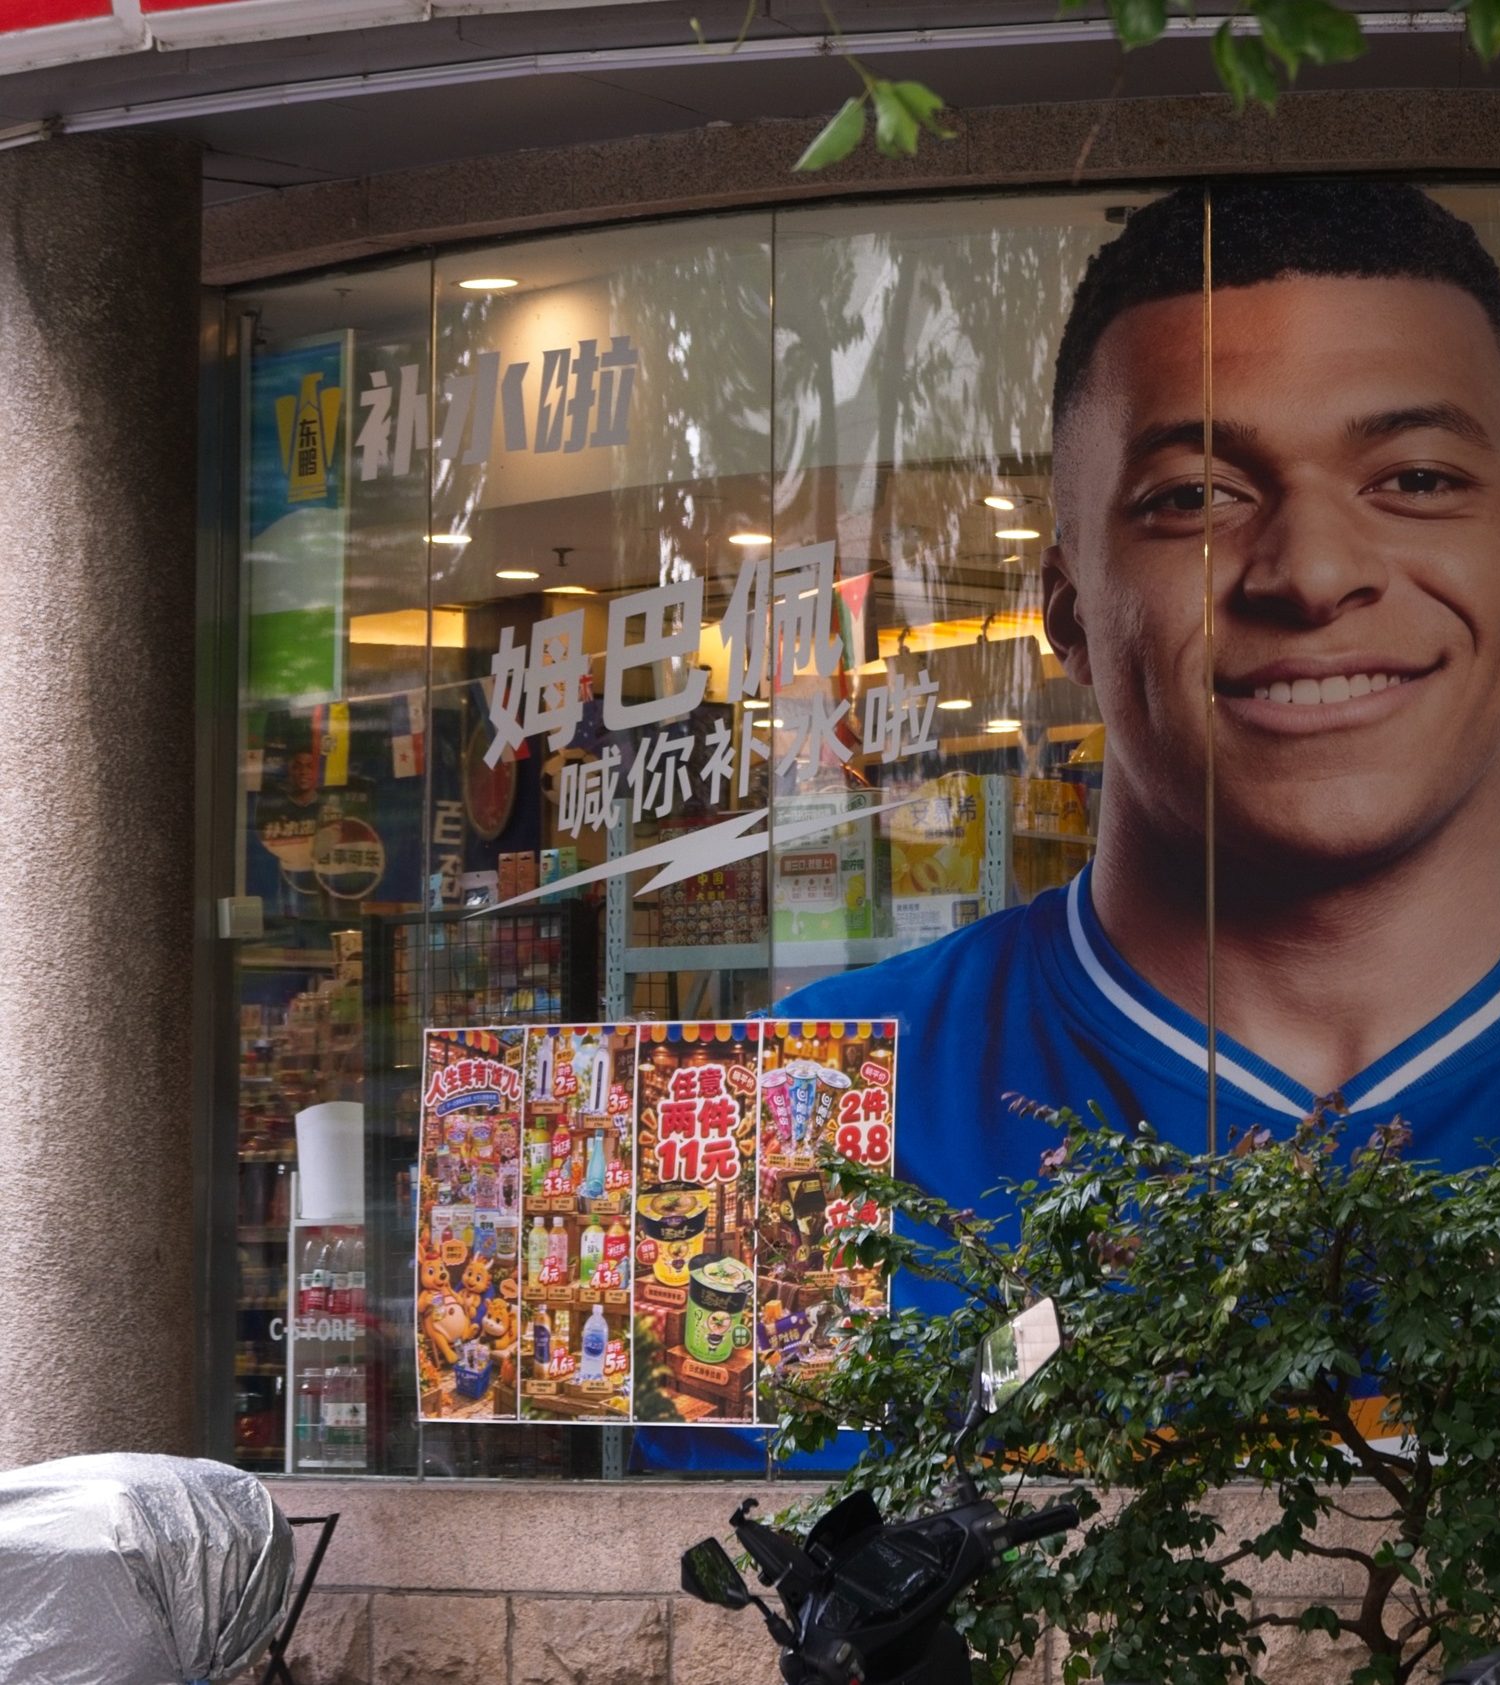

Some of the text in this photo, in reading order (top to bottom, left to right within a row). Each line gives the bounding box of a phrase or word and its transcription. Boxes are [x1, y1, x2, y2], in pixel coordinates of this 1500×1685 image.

[355, 335, 640, 481] 补水啦
[298, 417, 318, 477] 东鹏
[483, 540, 845, 770] 姆巴佩
[557, 669, 941, 840] 喊你补水啦
[555, 1076, 577, 1096] 2元
[671, 1067, 722, 1101] 任意
[608, 1094, 629, 1112] 3元
[840, 1089, 887, 1124] 2件
[660, 1098, 736, 1138] 两件
[837, 1124, 890, 1163] 8.8
[657, 1139, 737, 1180] 11元
[543, 1178, 571, 1196] 3.3元
[605, 1170, 630, 1190] 3.5元
[539, 1266, 560, 1284] 4元
[590, 1270, 619, 1289] 4.3元
[269, 1317, 356, 1342] C-STORE
[549, 1357, 574, 1377] 4.6元
[604, 1353, 627, 1374] 5元
